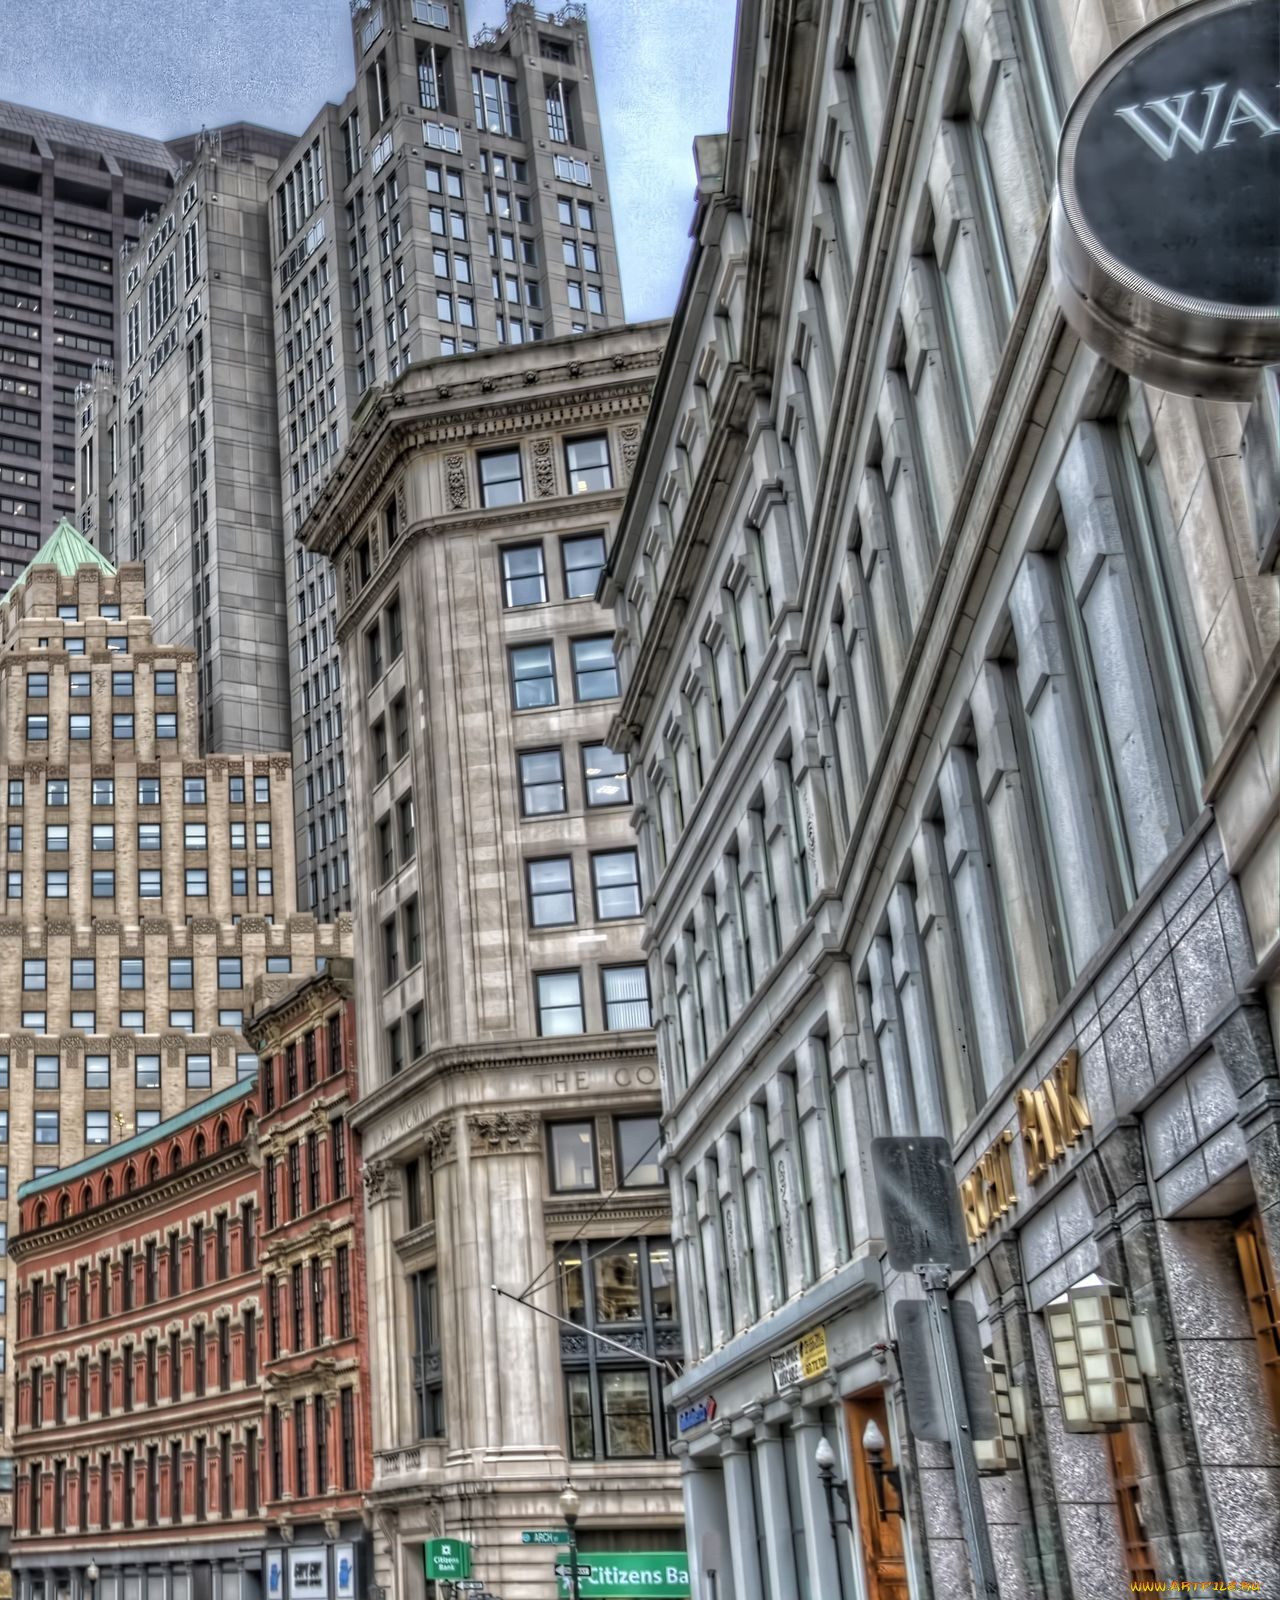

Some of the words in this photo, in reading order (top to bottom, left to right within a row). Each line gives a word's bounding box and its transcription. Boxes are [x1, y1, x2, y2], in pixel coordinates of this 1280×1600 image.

[1113, 81, 1280, 162] WA
[533, 1070, 590, 1094] THE
[614, 1065, 657, 1088] CO
[1014, 1047, 1093, 1187] BANK
[534, 1532, 553, 1543] ARCH
[433, 1556, 460, 1564] Citizens
[438, 1562, 455, 1571] Bank
[588, 1566, 663, 1585] Citizens
